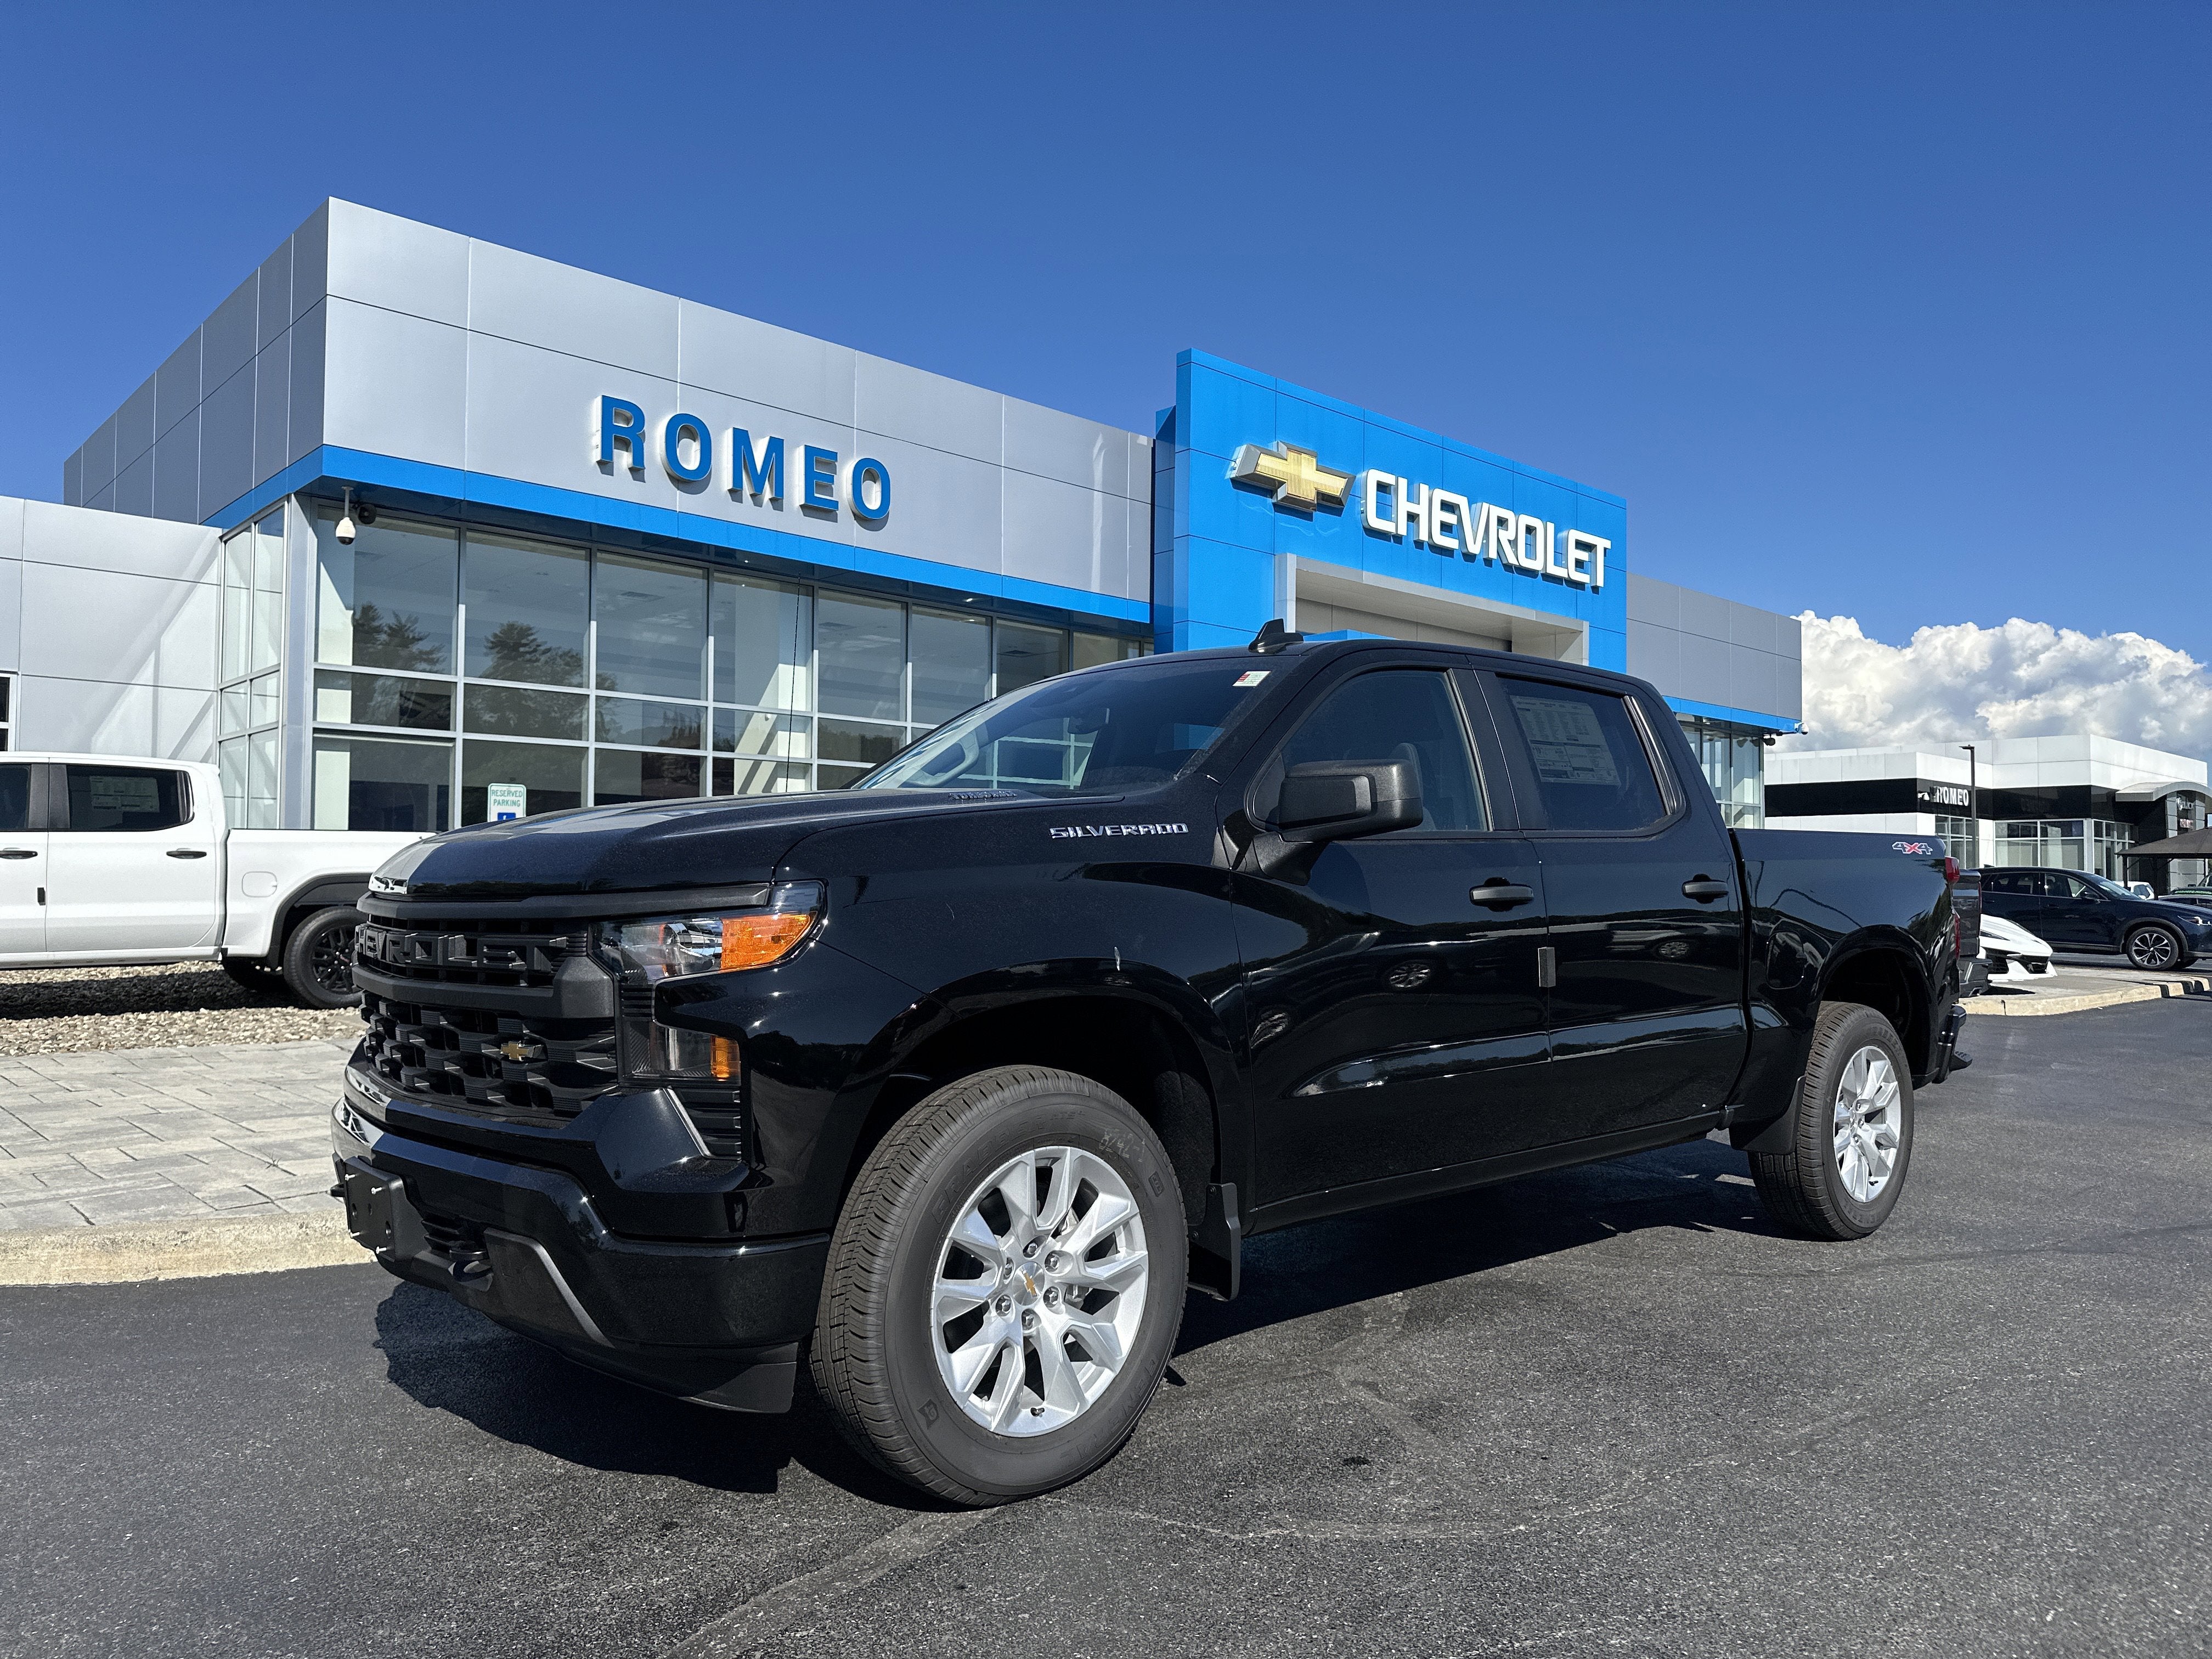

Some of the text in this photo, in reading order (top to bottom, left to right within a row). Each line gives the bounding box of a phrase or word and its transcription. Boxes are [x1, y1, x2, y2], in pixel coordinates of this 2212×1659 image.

[596, 394, 891, 520] ROMEO
[1361, 468, 1612, 588] CHEVROLET
[492, 789, 523, 798] RESERVED
[493, 799, 521, 807] PARKING
[1049, 823, 1189, 839] SILVERADO
